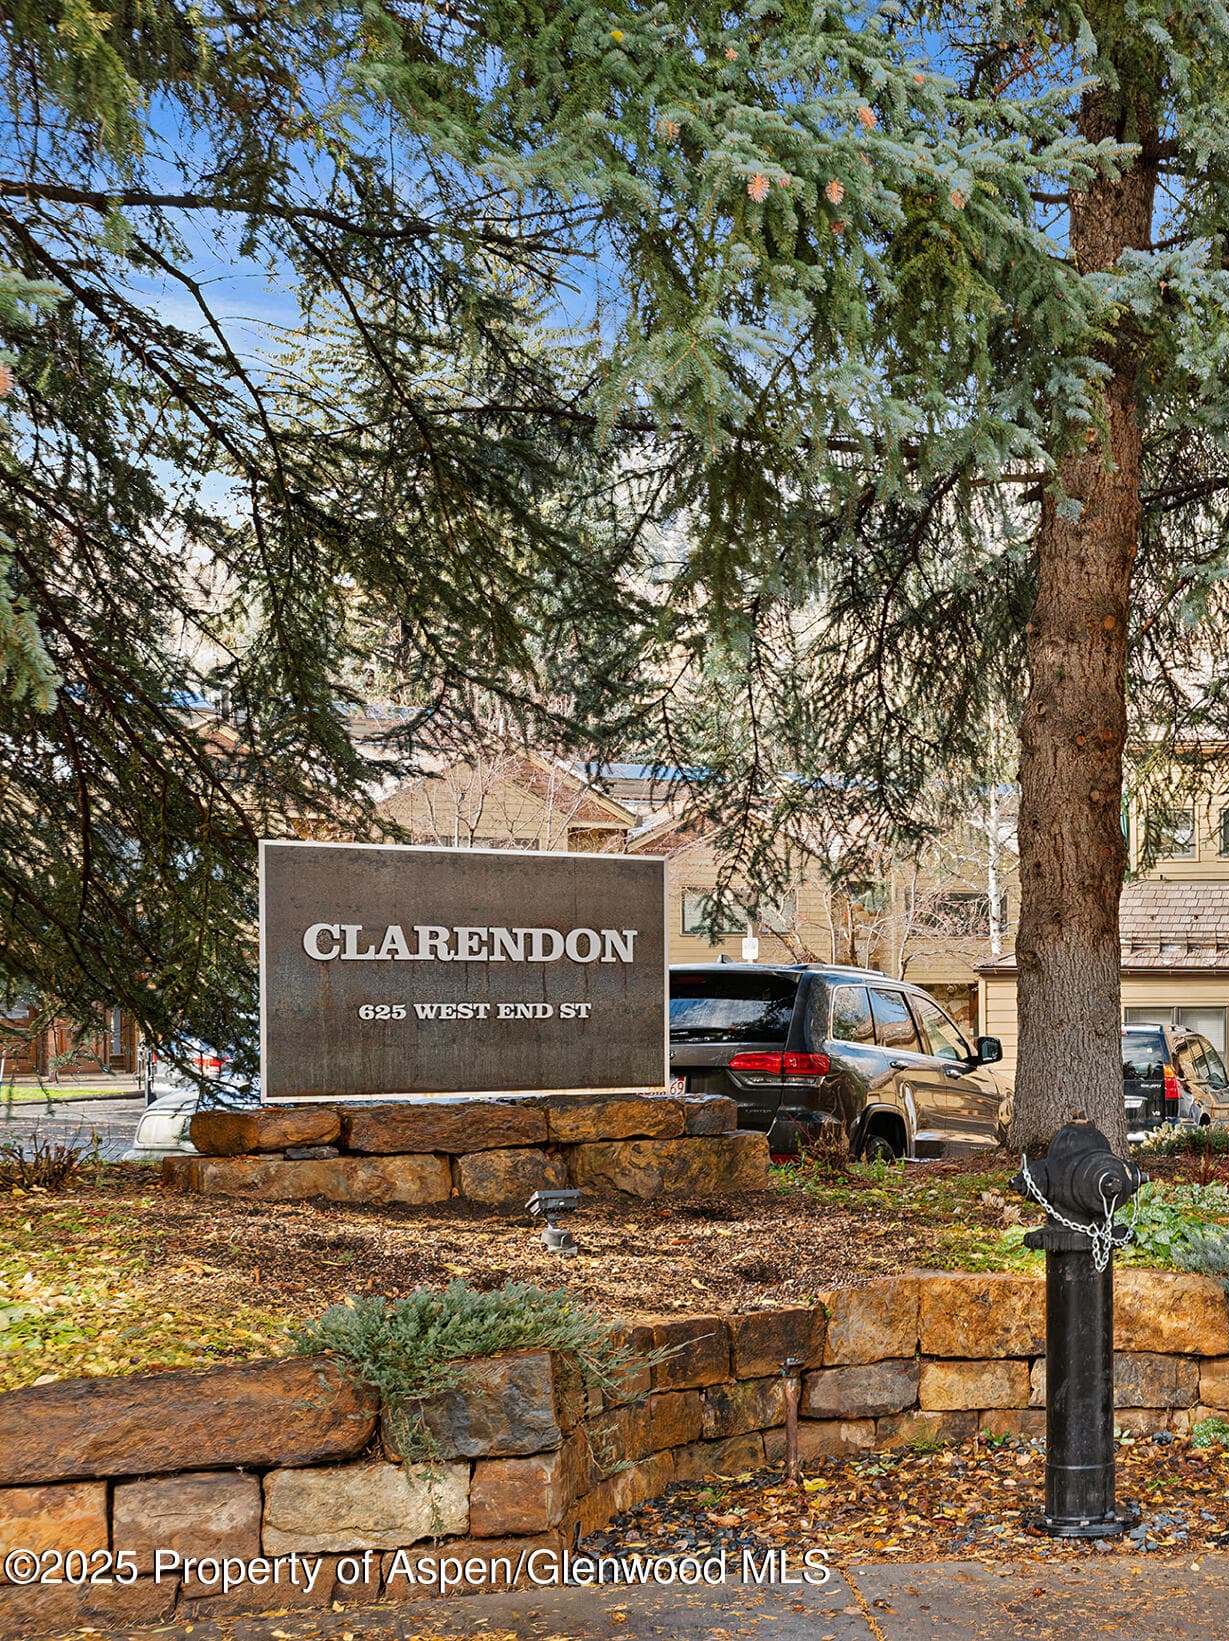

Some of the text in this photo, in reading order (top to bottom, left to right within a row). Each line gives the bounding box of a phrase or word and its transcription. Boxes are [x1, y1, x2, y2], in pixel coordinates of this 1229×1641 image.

[303, 923, 638, 963] CLARENDON
[358, 1003, 592, 1020] 625 WEST END ST
